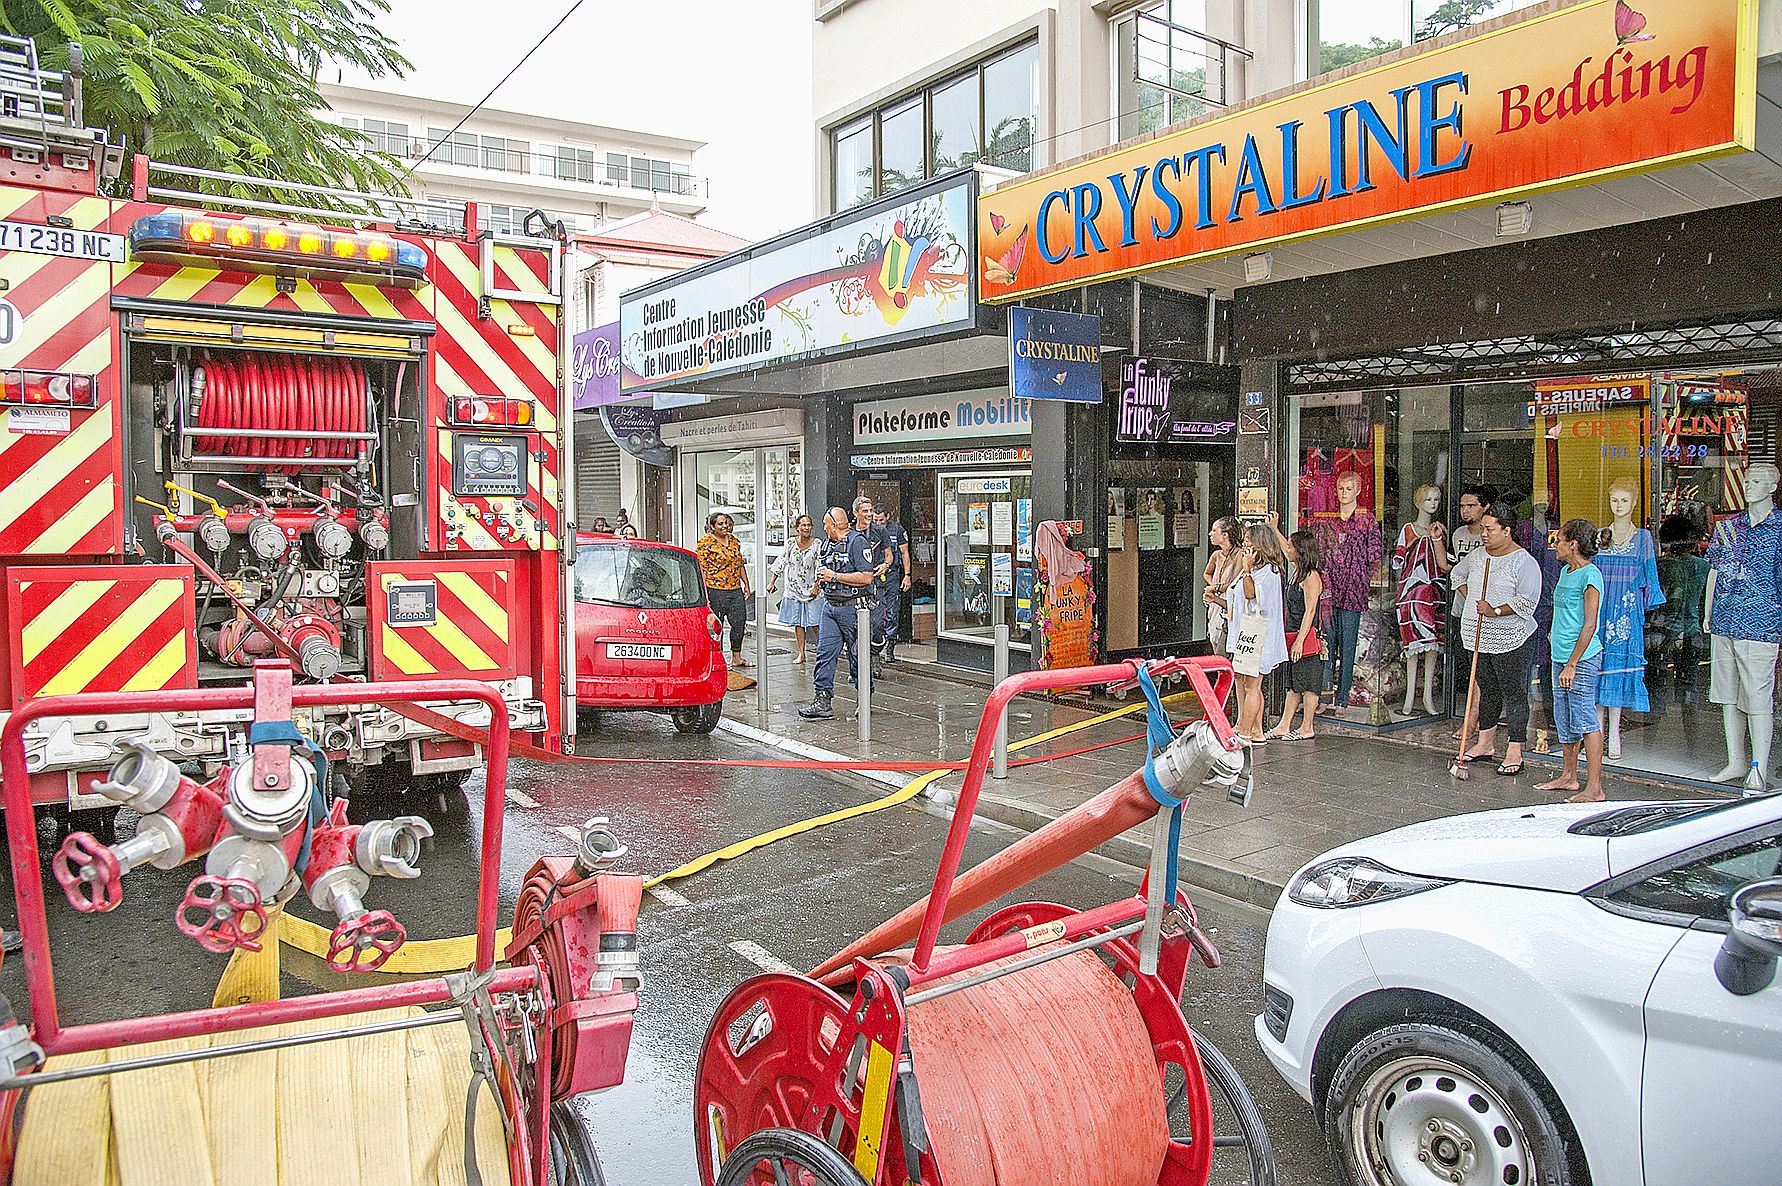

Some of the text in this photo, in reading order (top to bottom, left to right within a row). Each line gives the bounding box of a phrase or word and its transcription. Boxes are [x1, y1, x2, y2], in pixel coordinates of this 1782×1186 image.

[1496, 43, 1711, 137] Bedding
[1035, 71, 1473, 265] CRYSTALINE
[83, 234, 111, 257] NC
[643, 298, 676, 326] Centre
[643, 299, 765, 352] Information Jeunesse
[644, 326, 772, 377] de Nouvelle-Calédonie
[1016, 339, 1099, 363] CRYSTALINE
[680, 419, 758, 437] Nacre et perles de Tahiti
[858, 399, 1032, 435] Plateforme Mobilit
[1571, 415, 1741, 438] CRYSTALINE
[867, 455, 885, 466] Centre
[946, 451, 954, 463] de
[954, 449, 1018, 463] Nouvelle-Calédonie
[1600, 444, 1709, 458] TEL 28 22 28
[959, 480, 1009, 492] eurodesk
[1062, 584, 1073, 597] LA
[1060, 609, 1084, 623] FRIPE
